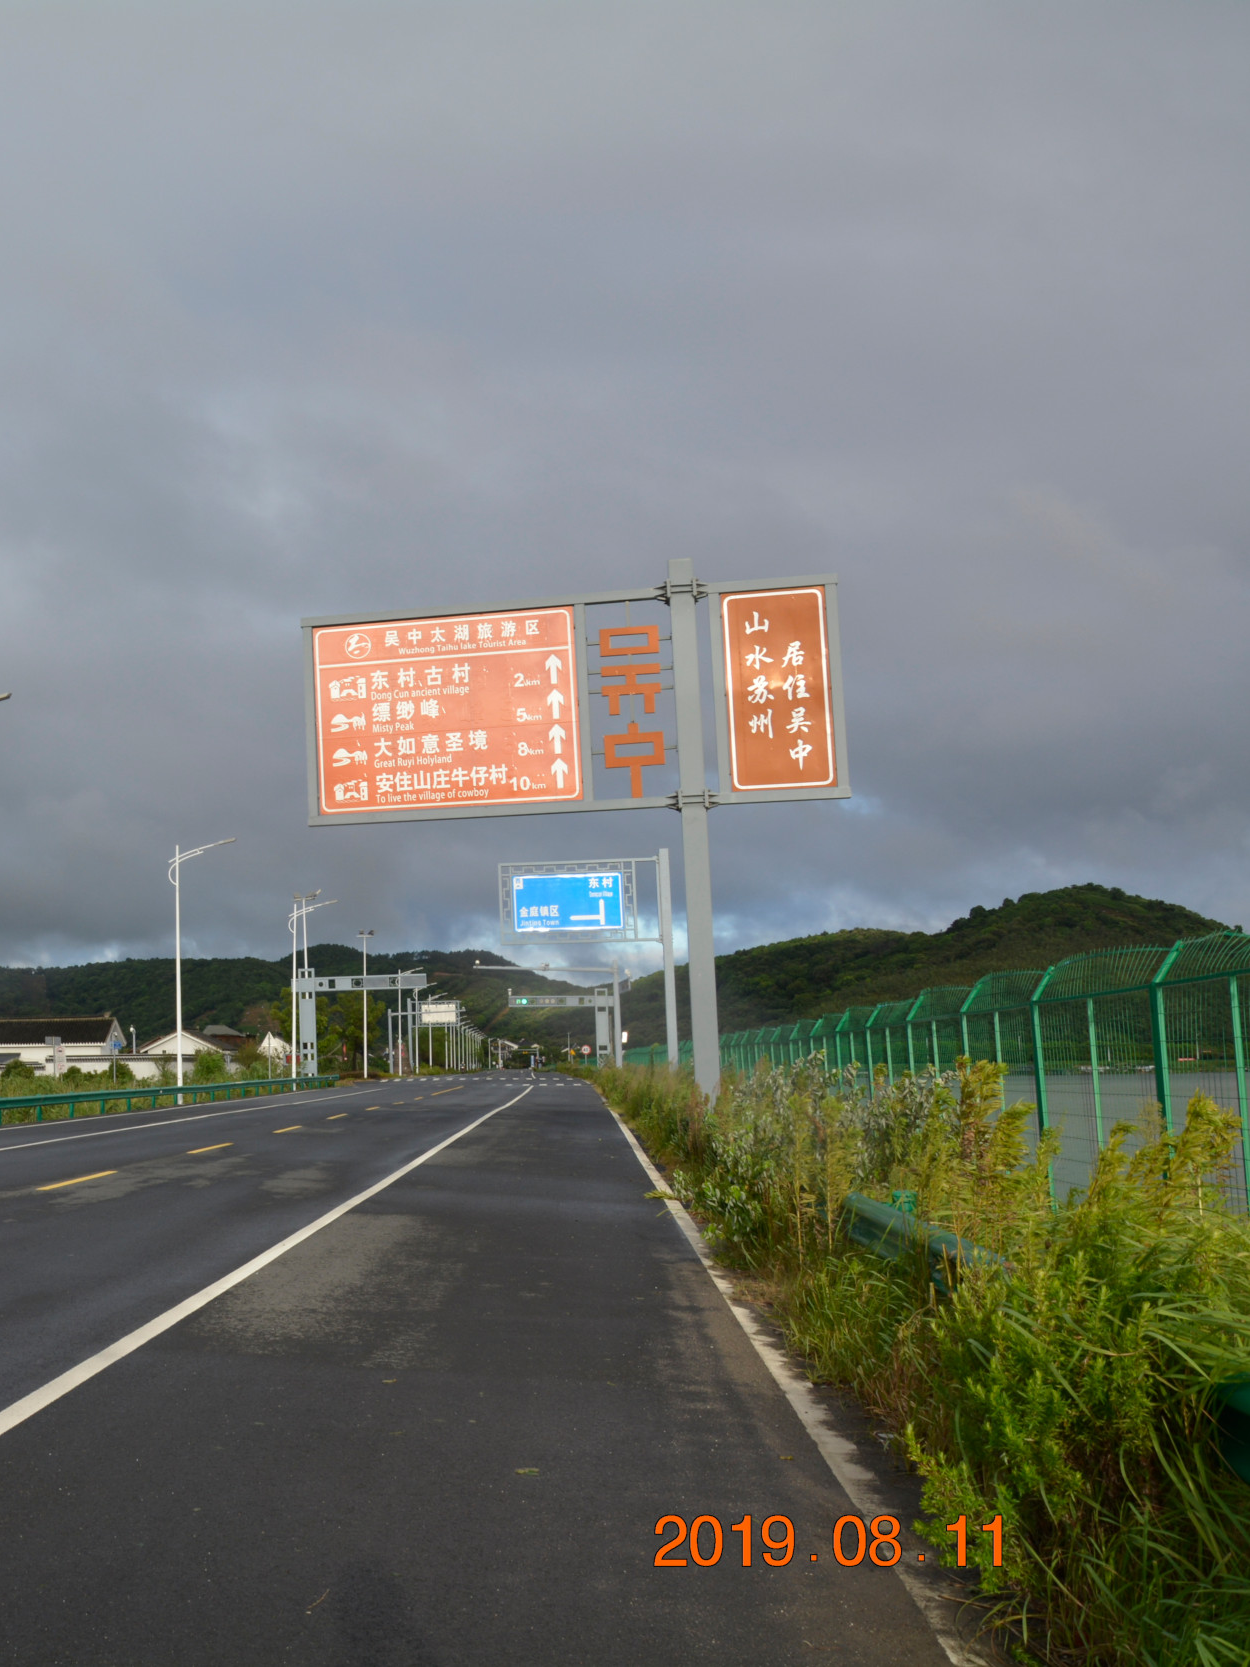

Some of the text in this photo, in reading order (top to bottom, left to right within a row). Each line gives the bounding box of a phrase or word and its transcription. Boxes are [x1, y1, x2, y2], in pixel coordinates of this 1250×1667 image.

[385, 619, 540, 647] 吴中太湖旅游区
[398, 638, 527, 655] Wuzhong Taihu lake Tourist Area
[370, 662, 471, 690] 东村古村
[744, 611, 775, 739] 山水苏州
[370, 685, 470, 702] Dong Cun ancient village
[372, 698, 440, 723] 缥缈峰
[782, 640, 813, 771] 居住吴中
[372, 721, 414, 734] Misty Peak
[373, 729, 489, 758] 大如意圣境
[374, 754, 453, 769] Great Ruyi Holyland
[375, 763, 508, 793] 安住山庄牛仔村
[376, 787, 490, 804] To live the village of cowboy
[588, 876, 614, 889] 东村
[519, 904, 560, 918] 金庭镇区
[543, 919, 560, 927] Town
